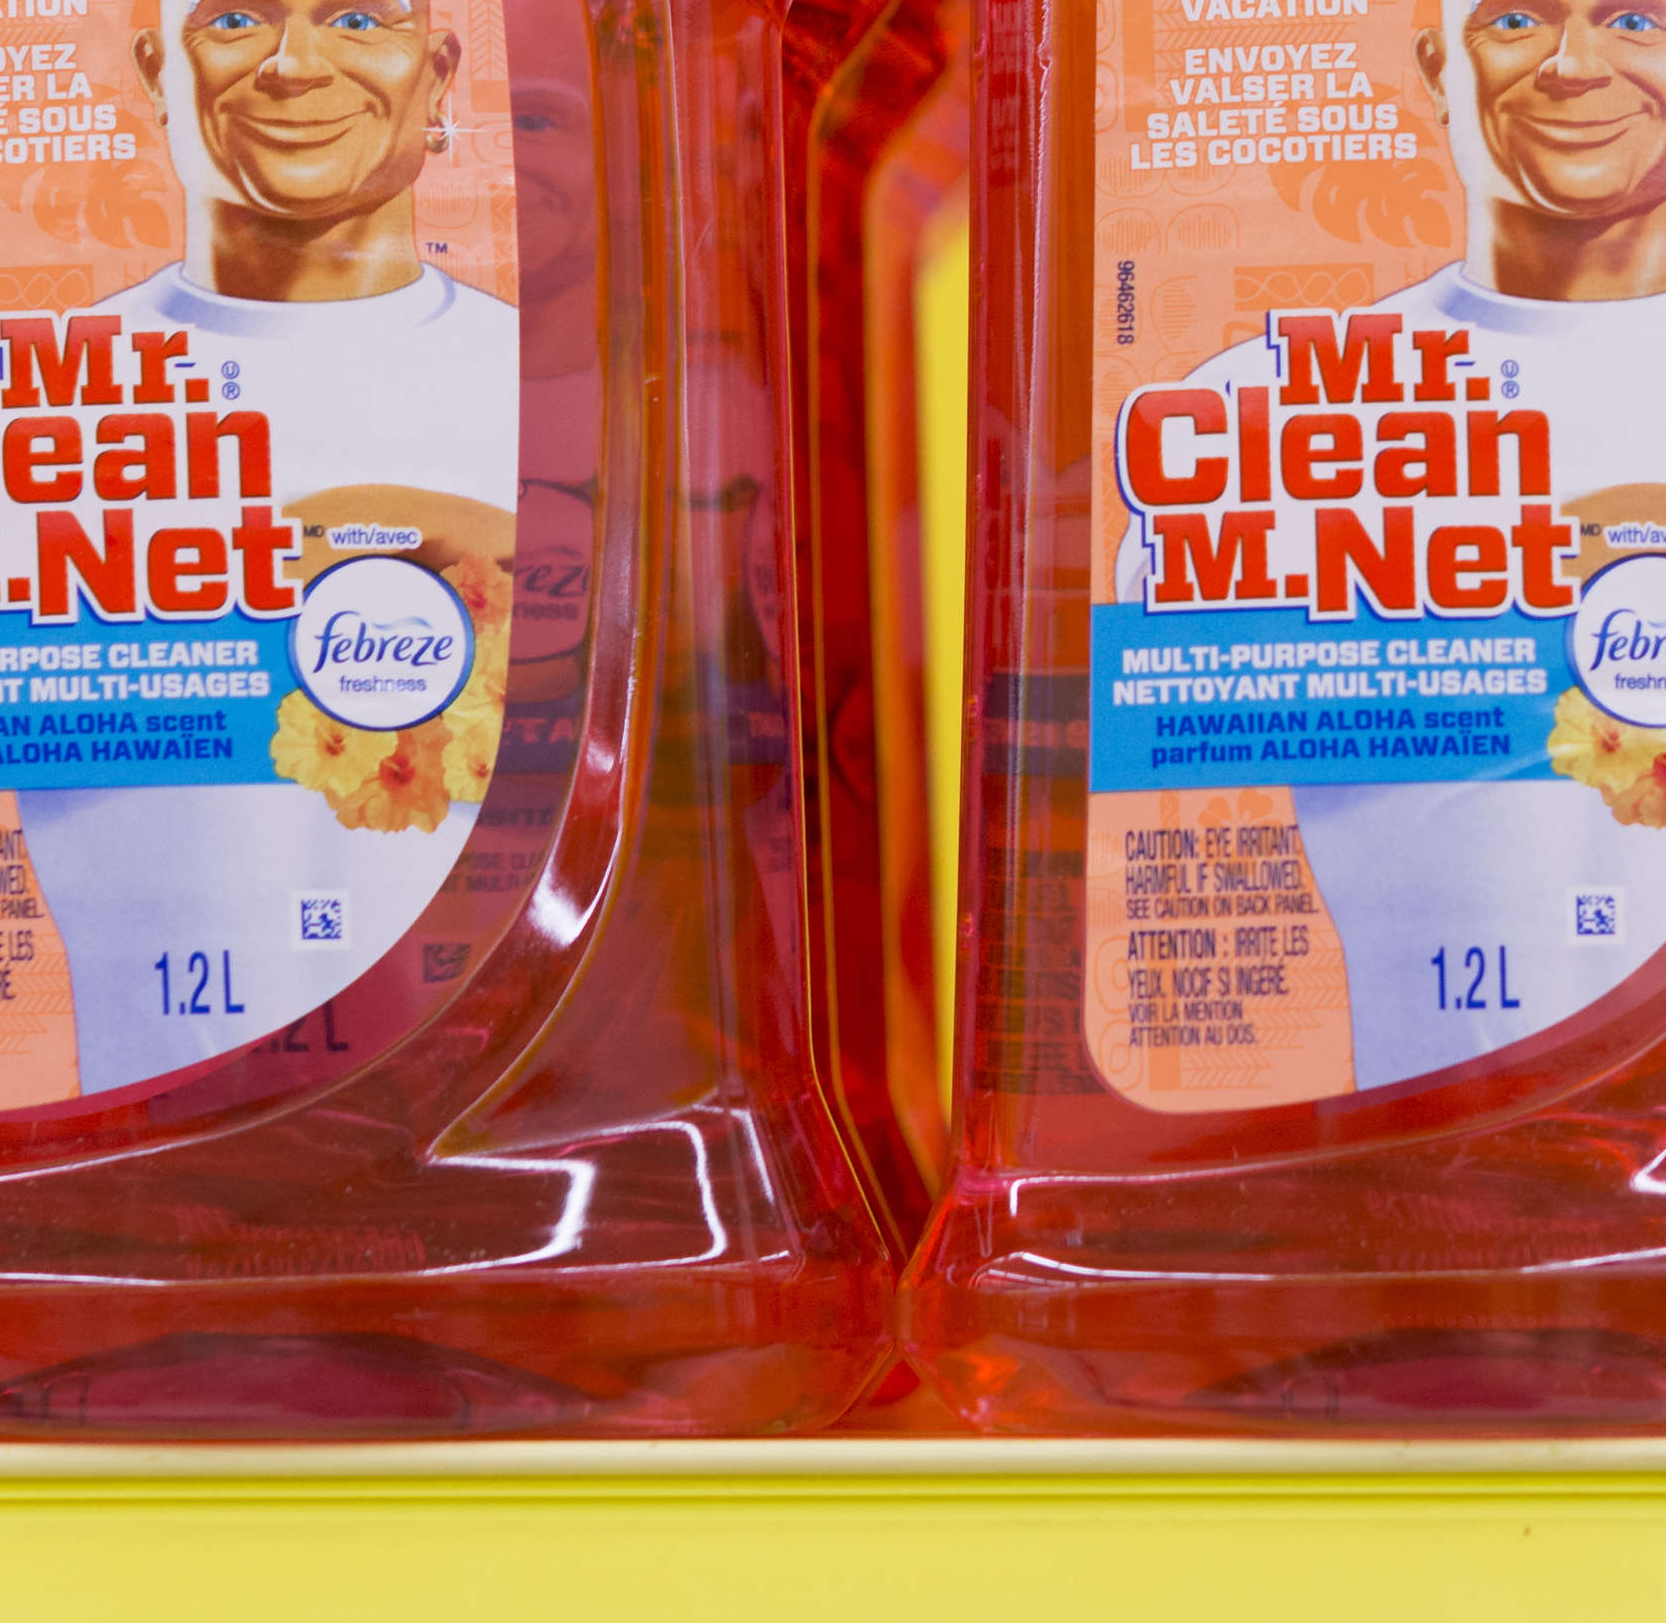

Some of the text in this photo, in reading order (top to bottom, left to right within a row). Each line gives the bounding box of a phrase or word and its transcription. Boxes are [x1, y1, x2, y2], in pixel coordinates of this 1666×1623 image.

[48, 71, 92, 99] LA
[17, 106, 117, 136] SOUS
[0, 314, 210, 410] Mr.
[1277, 313, 1491, 407] Mr.
[1128, 387, 1552, 508] Clean
[333, 525, 418, 548] with/avec
[108, 639, 258, 670] CLEANER
[313, 609, 454, 673] febreze
[1123, 638, 1535, 676] MULTI-PURPOSE CLEANER
[30, 670, 269, 703] MULTI-USAGES
[339, 674, 427, 695] freshness
[41, 711, 136, 739] ALOHA
[144, 709, 227, 734] scent
[90, 729, 232, 760] HAWAÏEN
[154, 950, 245, 1016] 1.2 L
